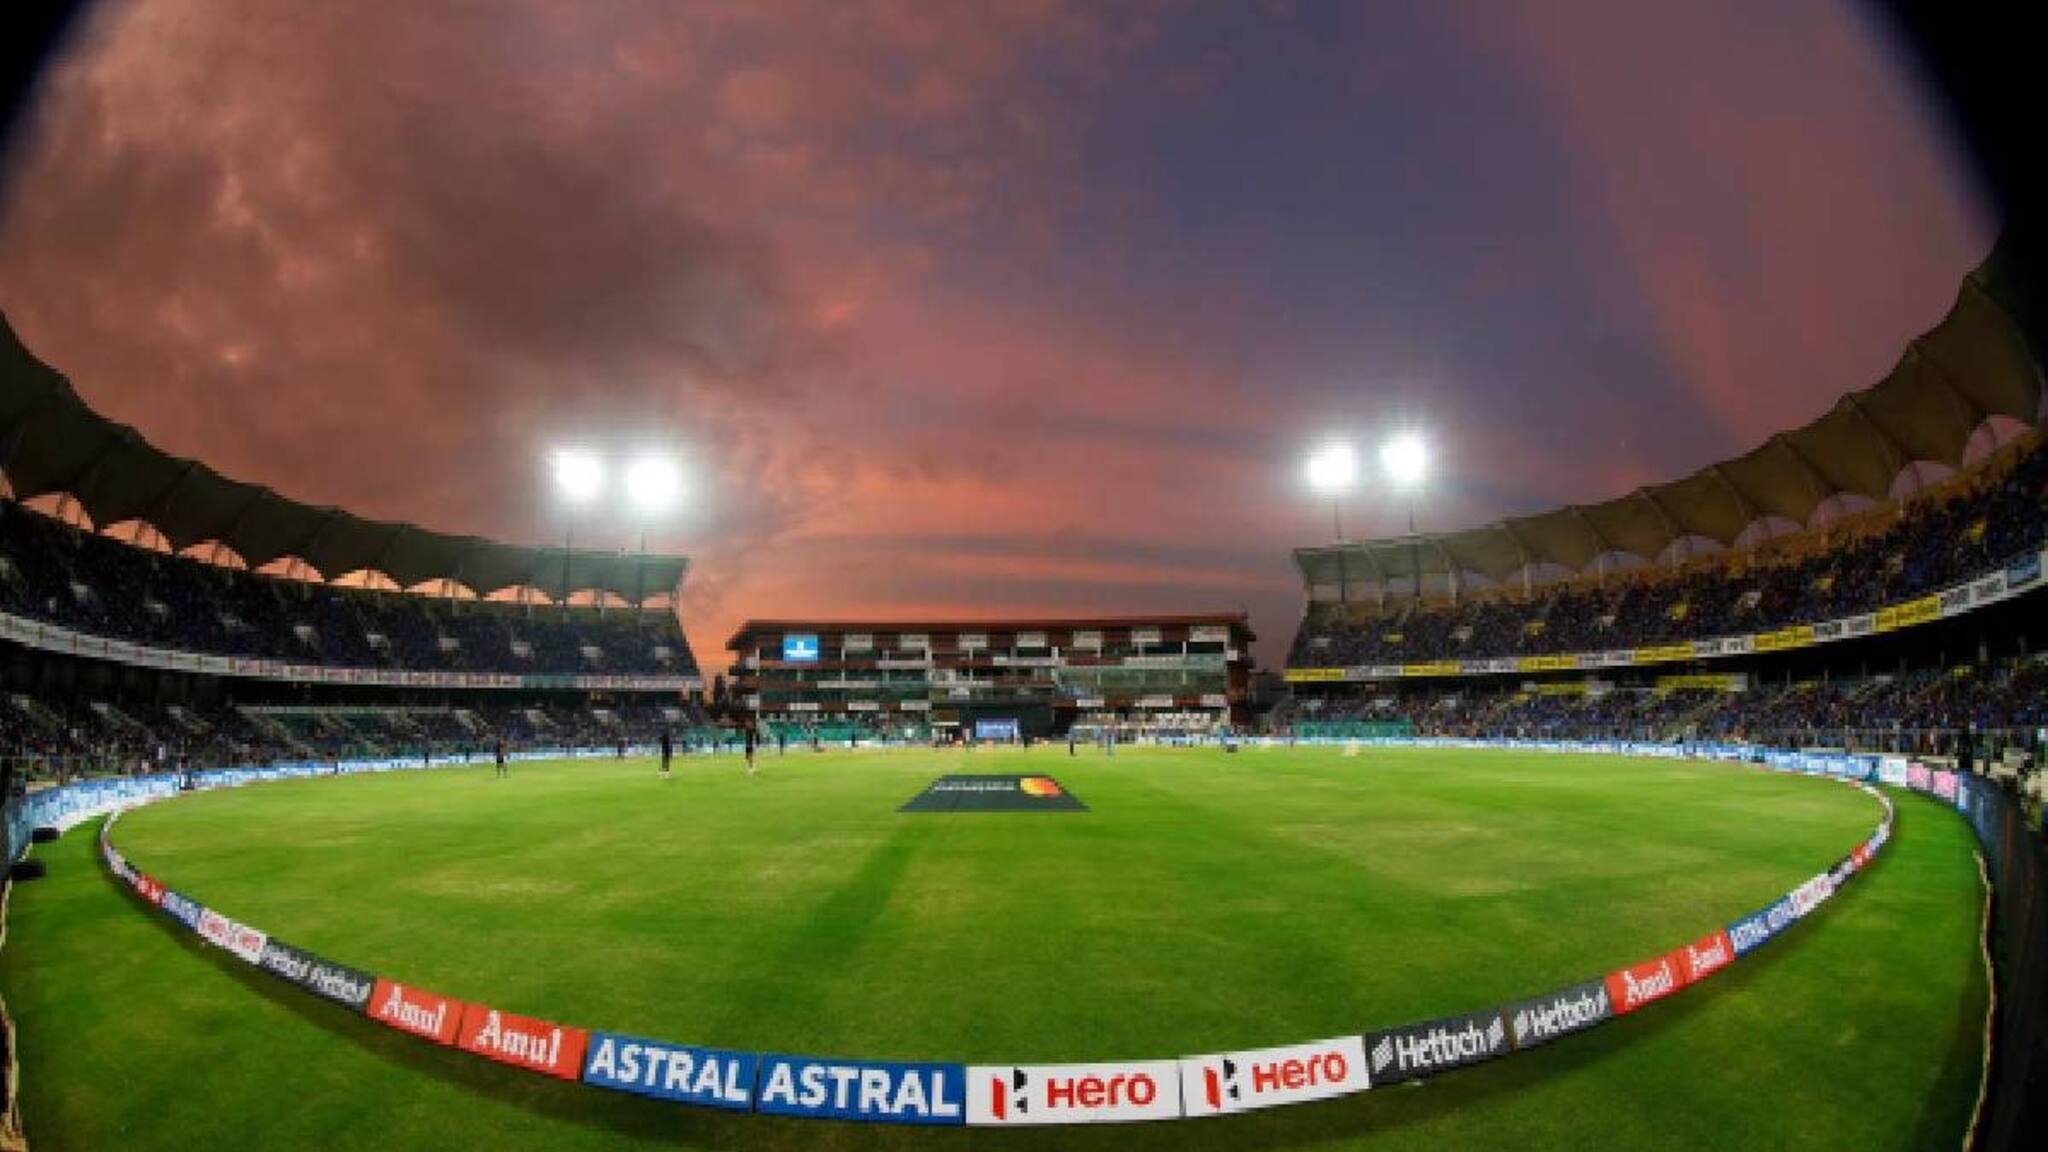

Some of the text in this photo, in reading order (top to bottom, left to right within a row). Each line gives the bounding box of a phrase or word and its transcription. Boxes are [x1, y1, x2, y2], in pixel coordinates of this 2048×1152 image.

[380, 984, 447, 1036] Amul
[476, 1010, 561, 1068] Amul
[1395, 1020, 1487, 1070] Hettich
[590, 1038, 749, 1102] ASTRAL
[762, 1062, 960, 1117] ASTRAL
